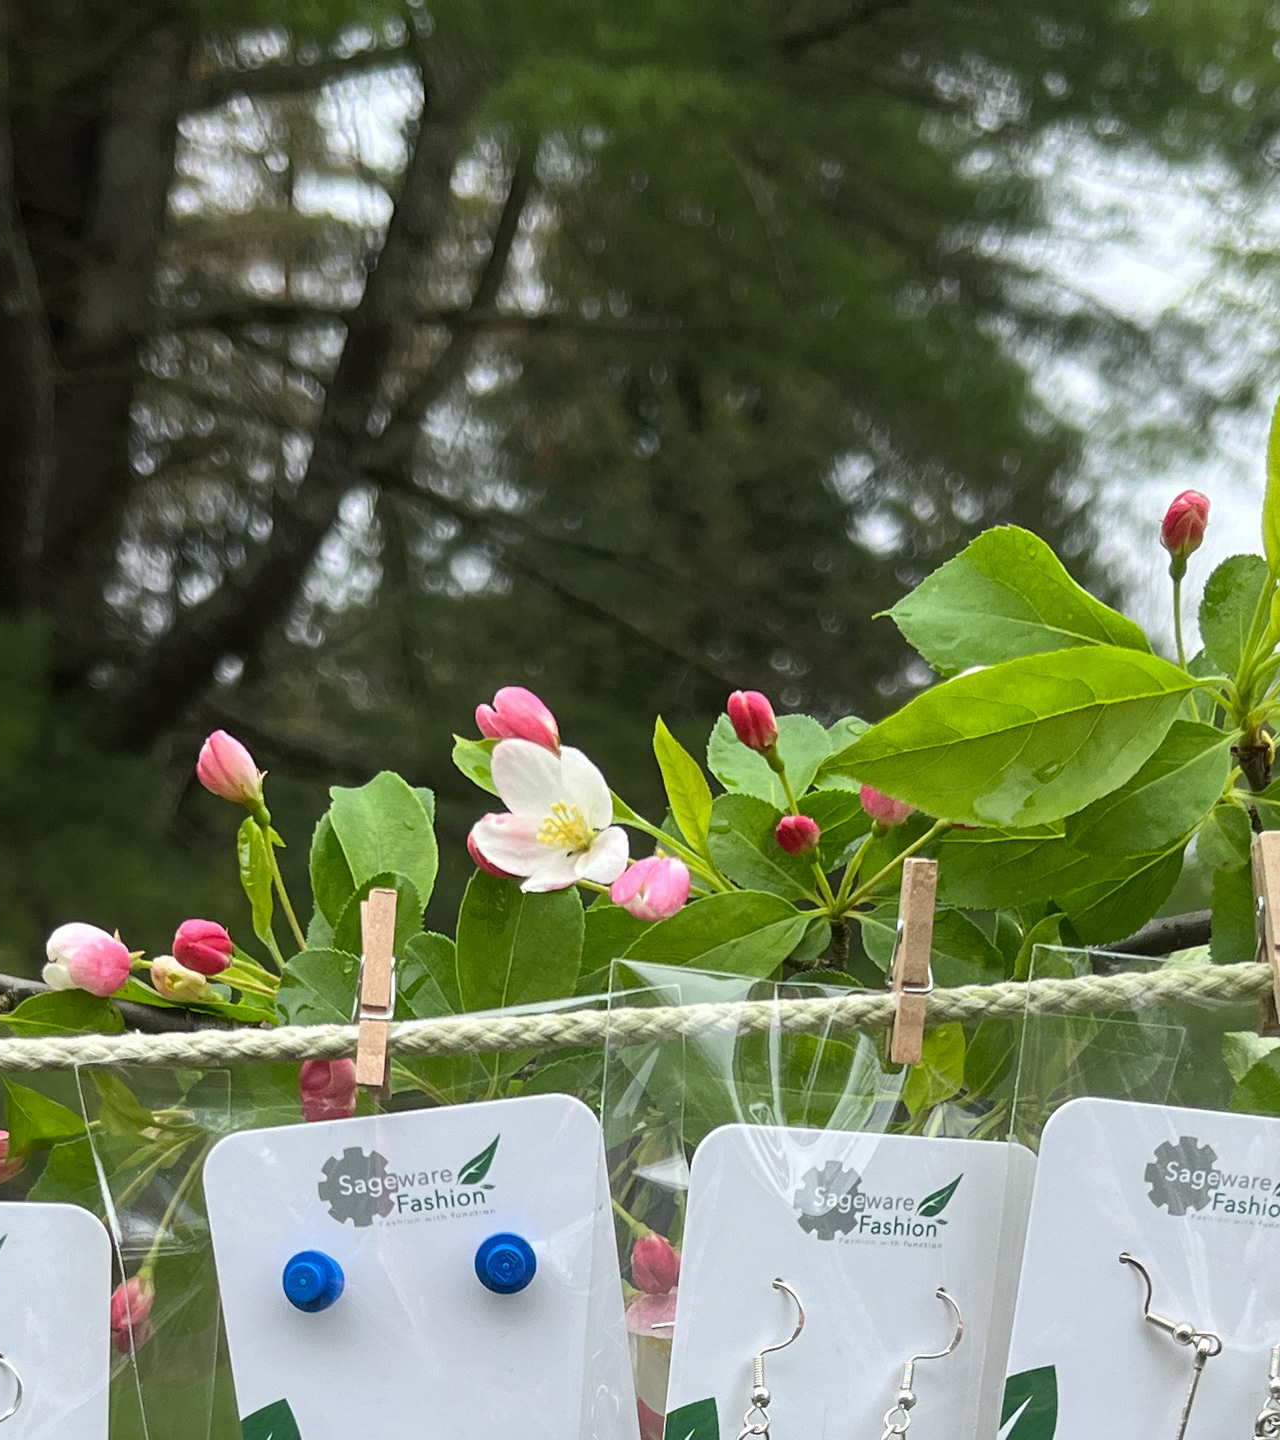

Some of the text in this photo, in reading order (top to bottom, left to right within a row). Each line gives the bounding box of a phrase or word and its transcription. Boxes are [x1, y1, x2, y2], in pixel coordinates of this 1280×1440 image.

[339, 1168, 452, 1198] Sageware
[1165, 1161, 1271, 1191] Sageware
[396, 1189, 486, 1214] Fashion
[814, 1186, 914, 1213] Sageware
[859, 1215, 937, 1237] Fashion
